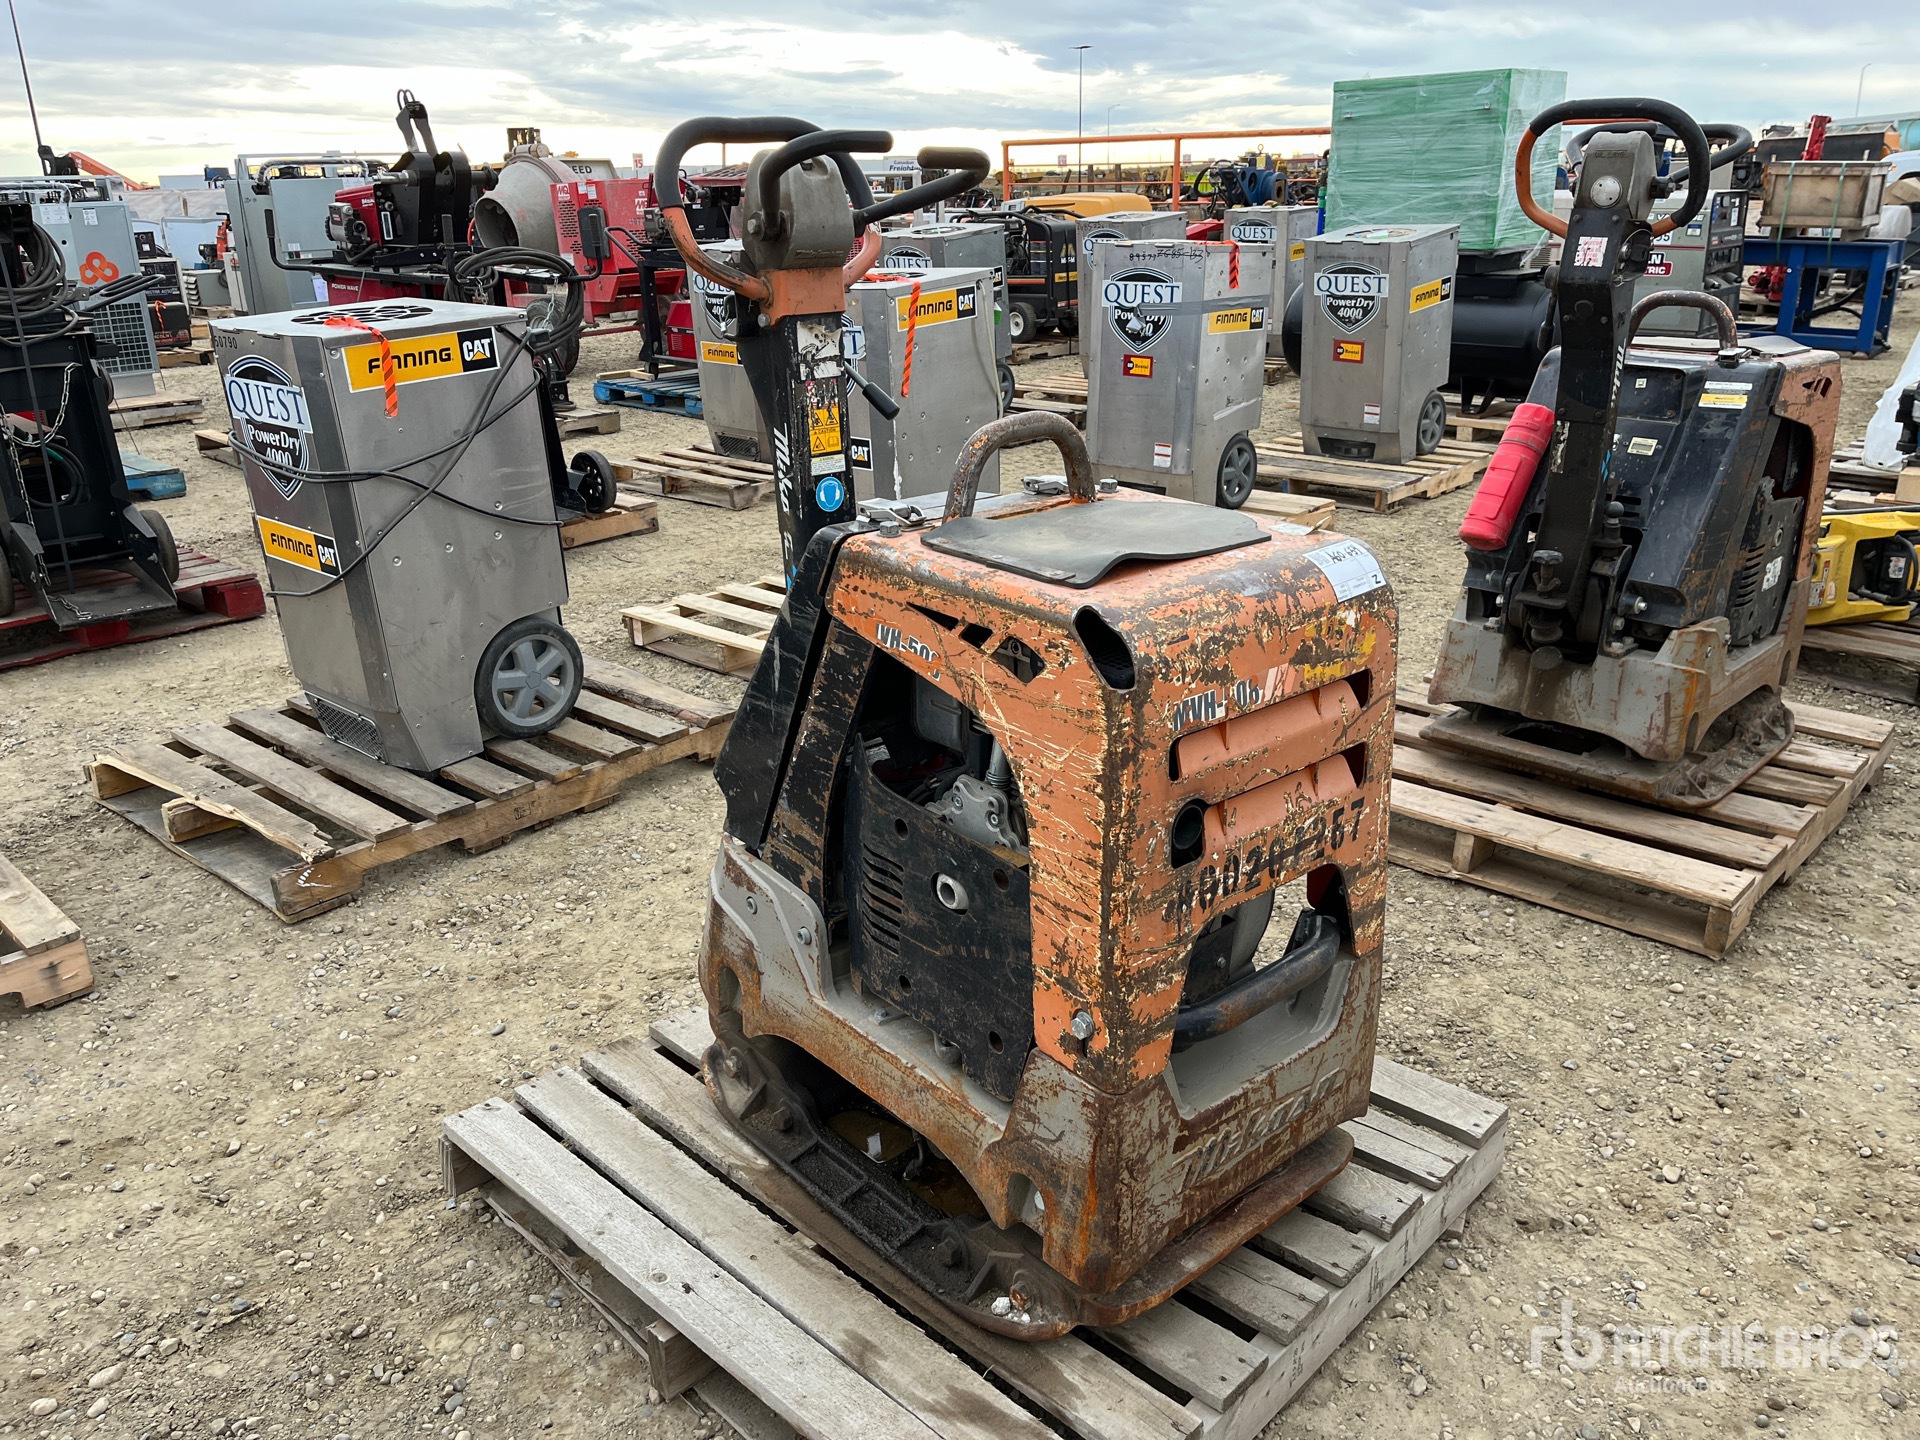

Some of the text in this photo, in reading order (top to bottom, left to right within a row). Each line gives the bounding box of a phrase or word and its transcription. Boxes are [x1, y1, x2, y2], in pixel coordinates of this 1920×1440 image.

[571, 165, 593, 174] EED
[1231, 227, 1276, 240] QUEST
[331, 283, 346, 291] POWER
[993, 272, 1002, 284] AT
[1316, 275, 1387, 297] QUEST
[1104, 282, 1180, 310] QUEST
[1326, 297, 1375, 310] PowerDry
[1415, 288, 1439, 304] FINNING
[908, 293, 974, 319] INNING CAT
[1215, 309, 1264, 325] FINNING CAT
[462, 338, 493, 363] CAT
[707, 348, 735, 359] FINNING
[367, 347, 452, 374] FNNING
[228, 380, 306, 425] QUEST
[247, 424, 300, 456] PowerDry
[851, 444, 870, 462] CAT
[270, 532, 336, 568] FINNING CAT
